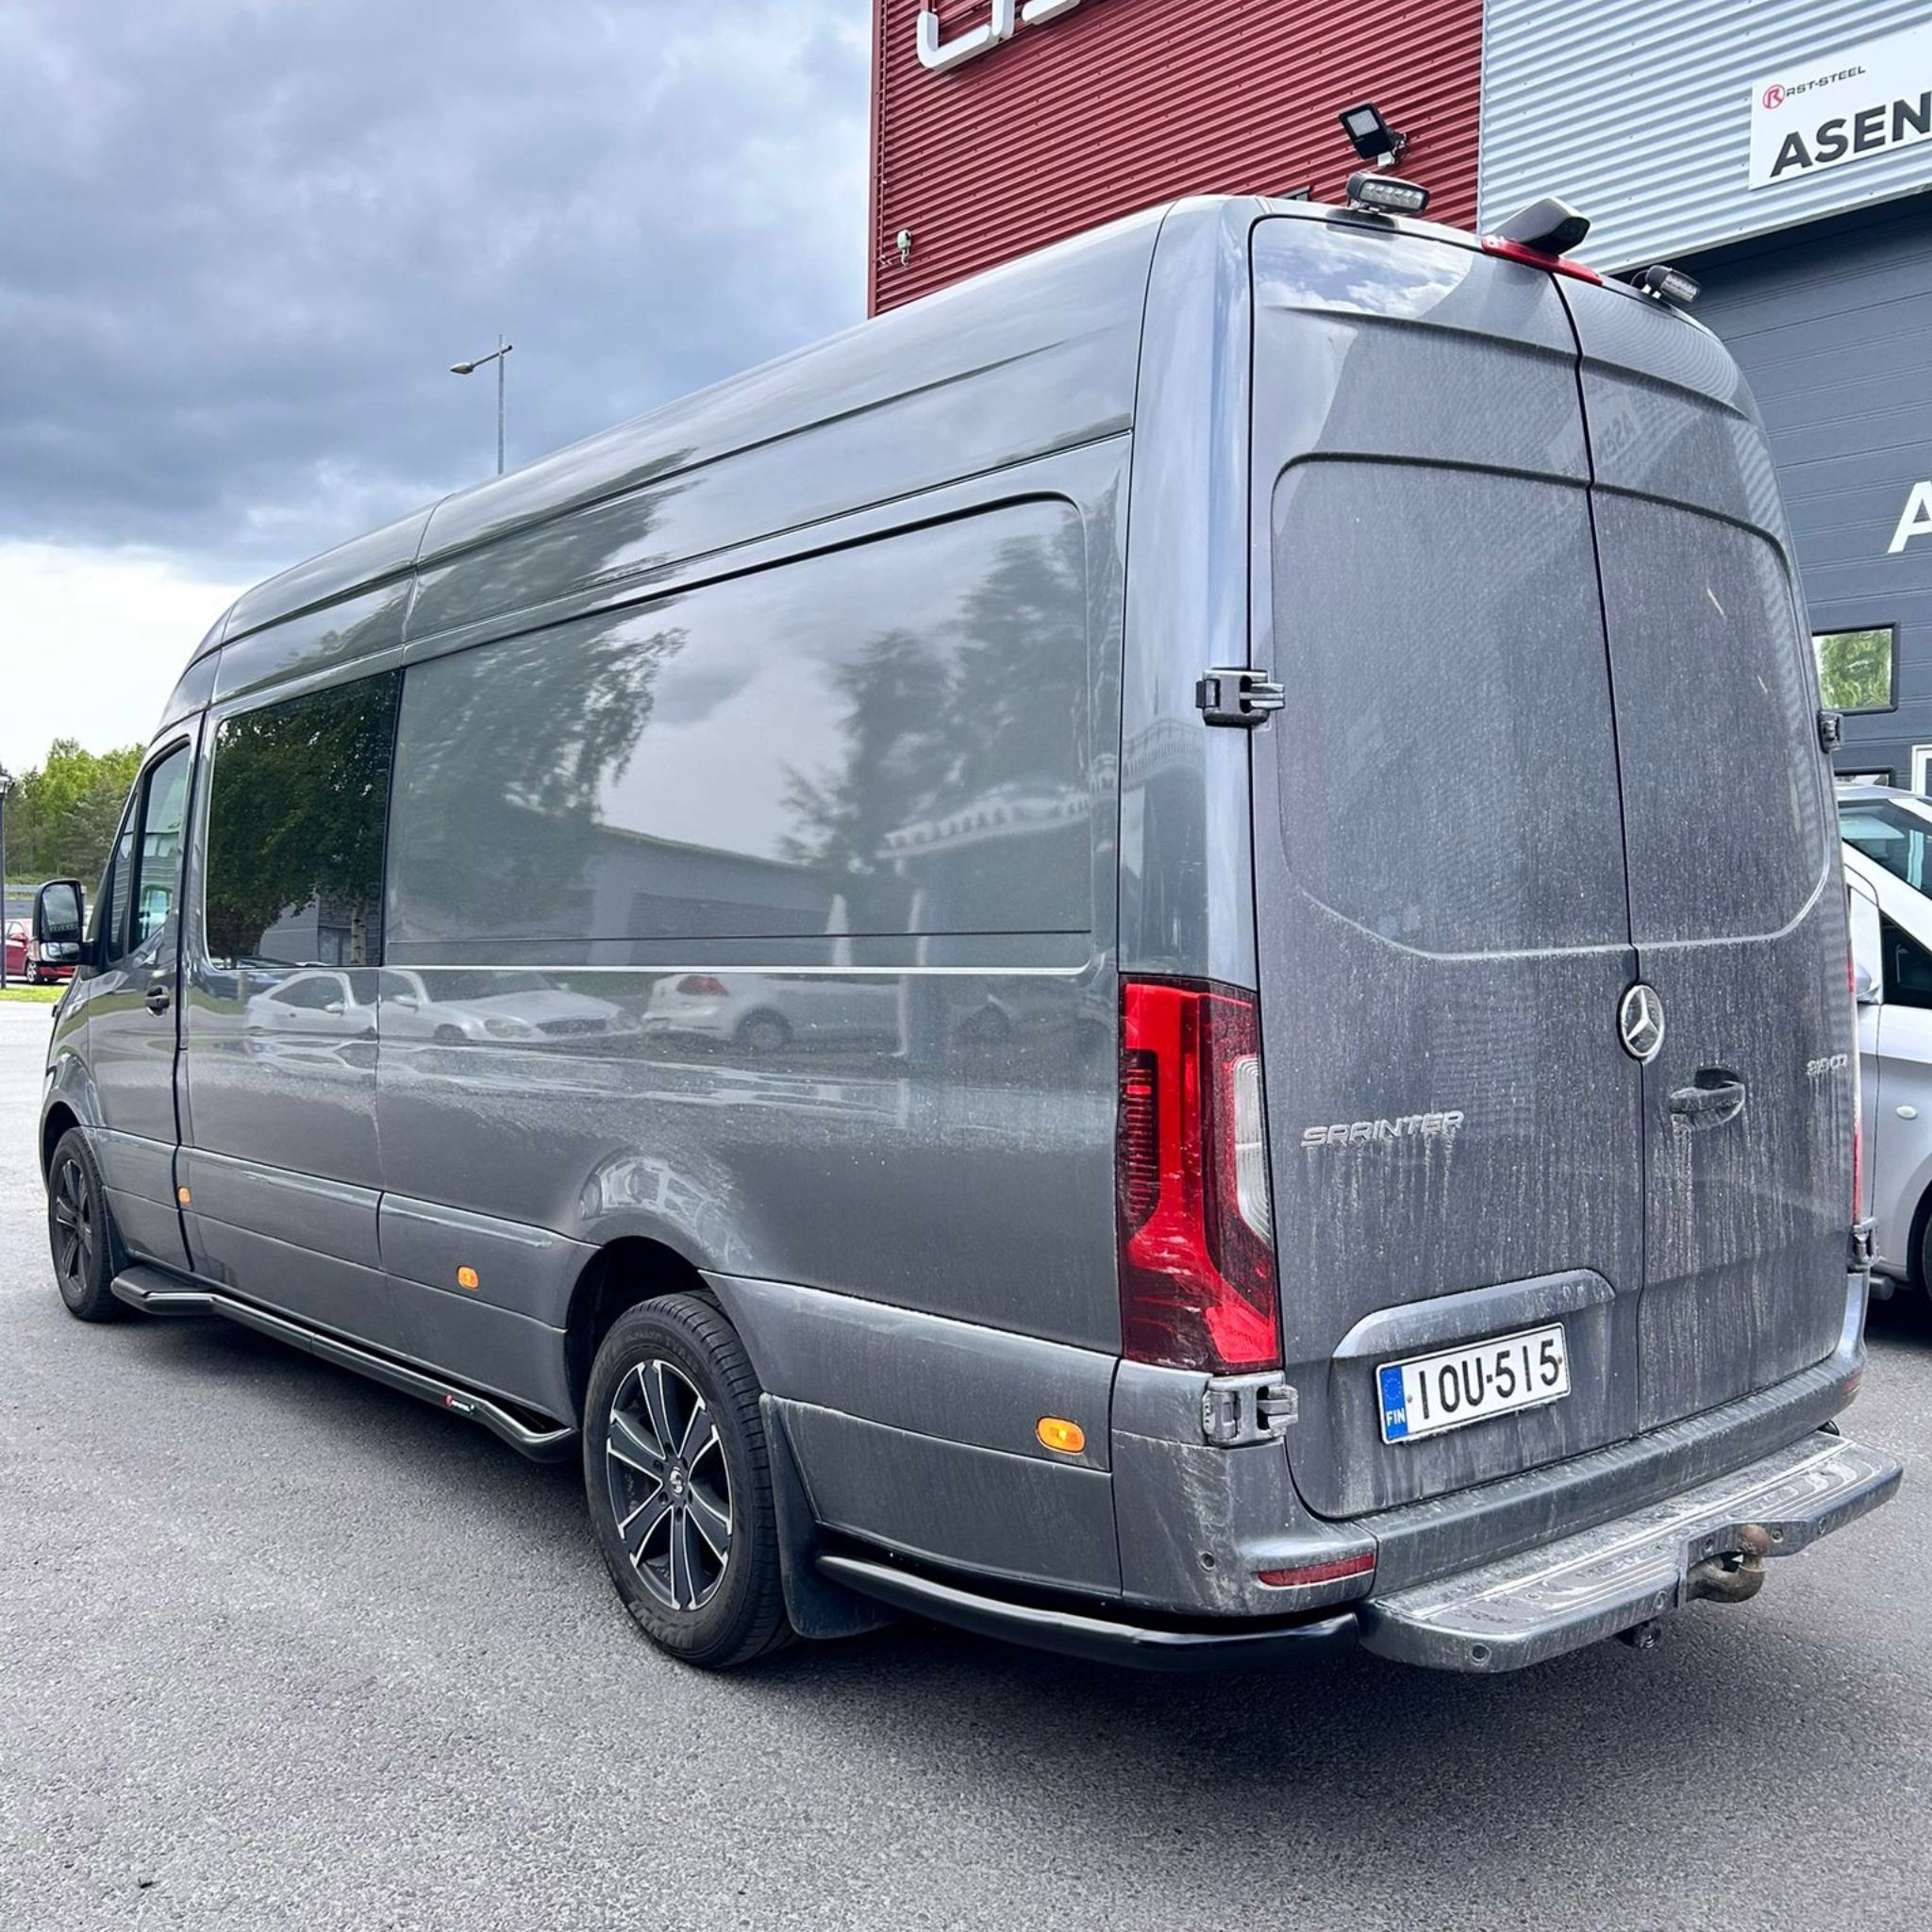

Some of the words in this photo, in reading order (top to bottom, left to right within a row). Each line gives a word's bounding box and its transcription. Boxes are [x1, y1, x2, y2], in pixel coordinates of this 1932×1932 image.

[1770, 91, 1932, 177] ASEN
[1301, 1109, 1464, 1147] SPRINTER
[1419, 1339, 1559, 1419] IOU-515
[1385, 1408, 1406, 1426] FIN
